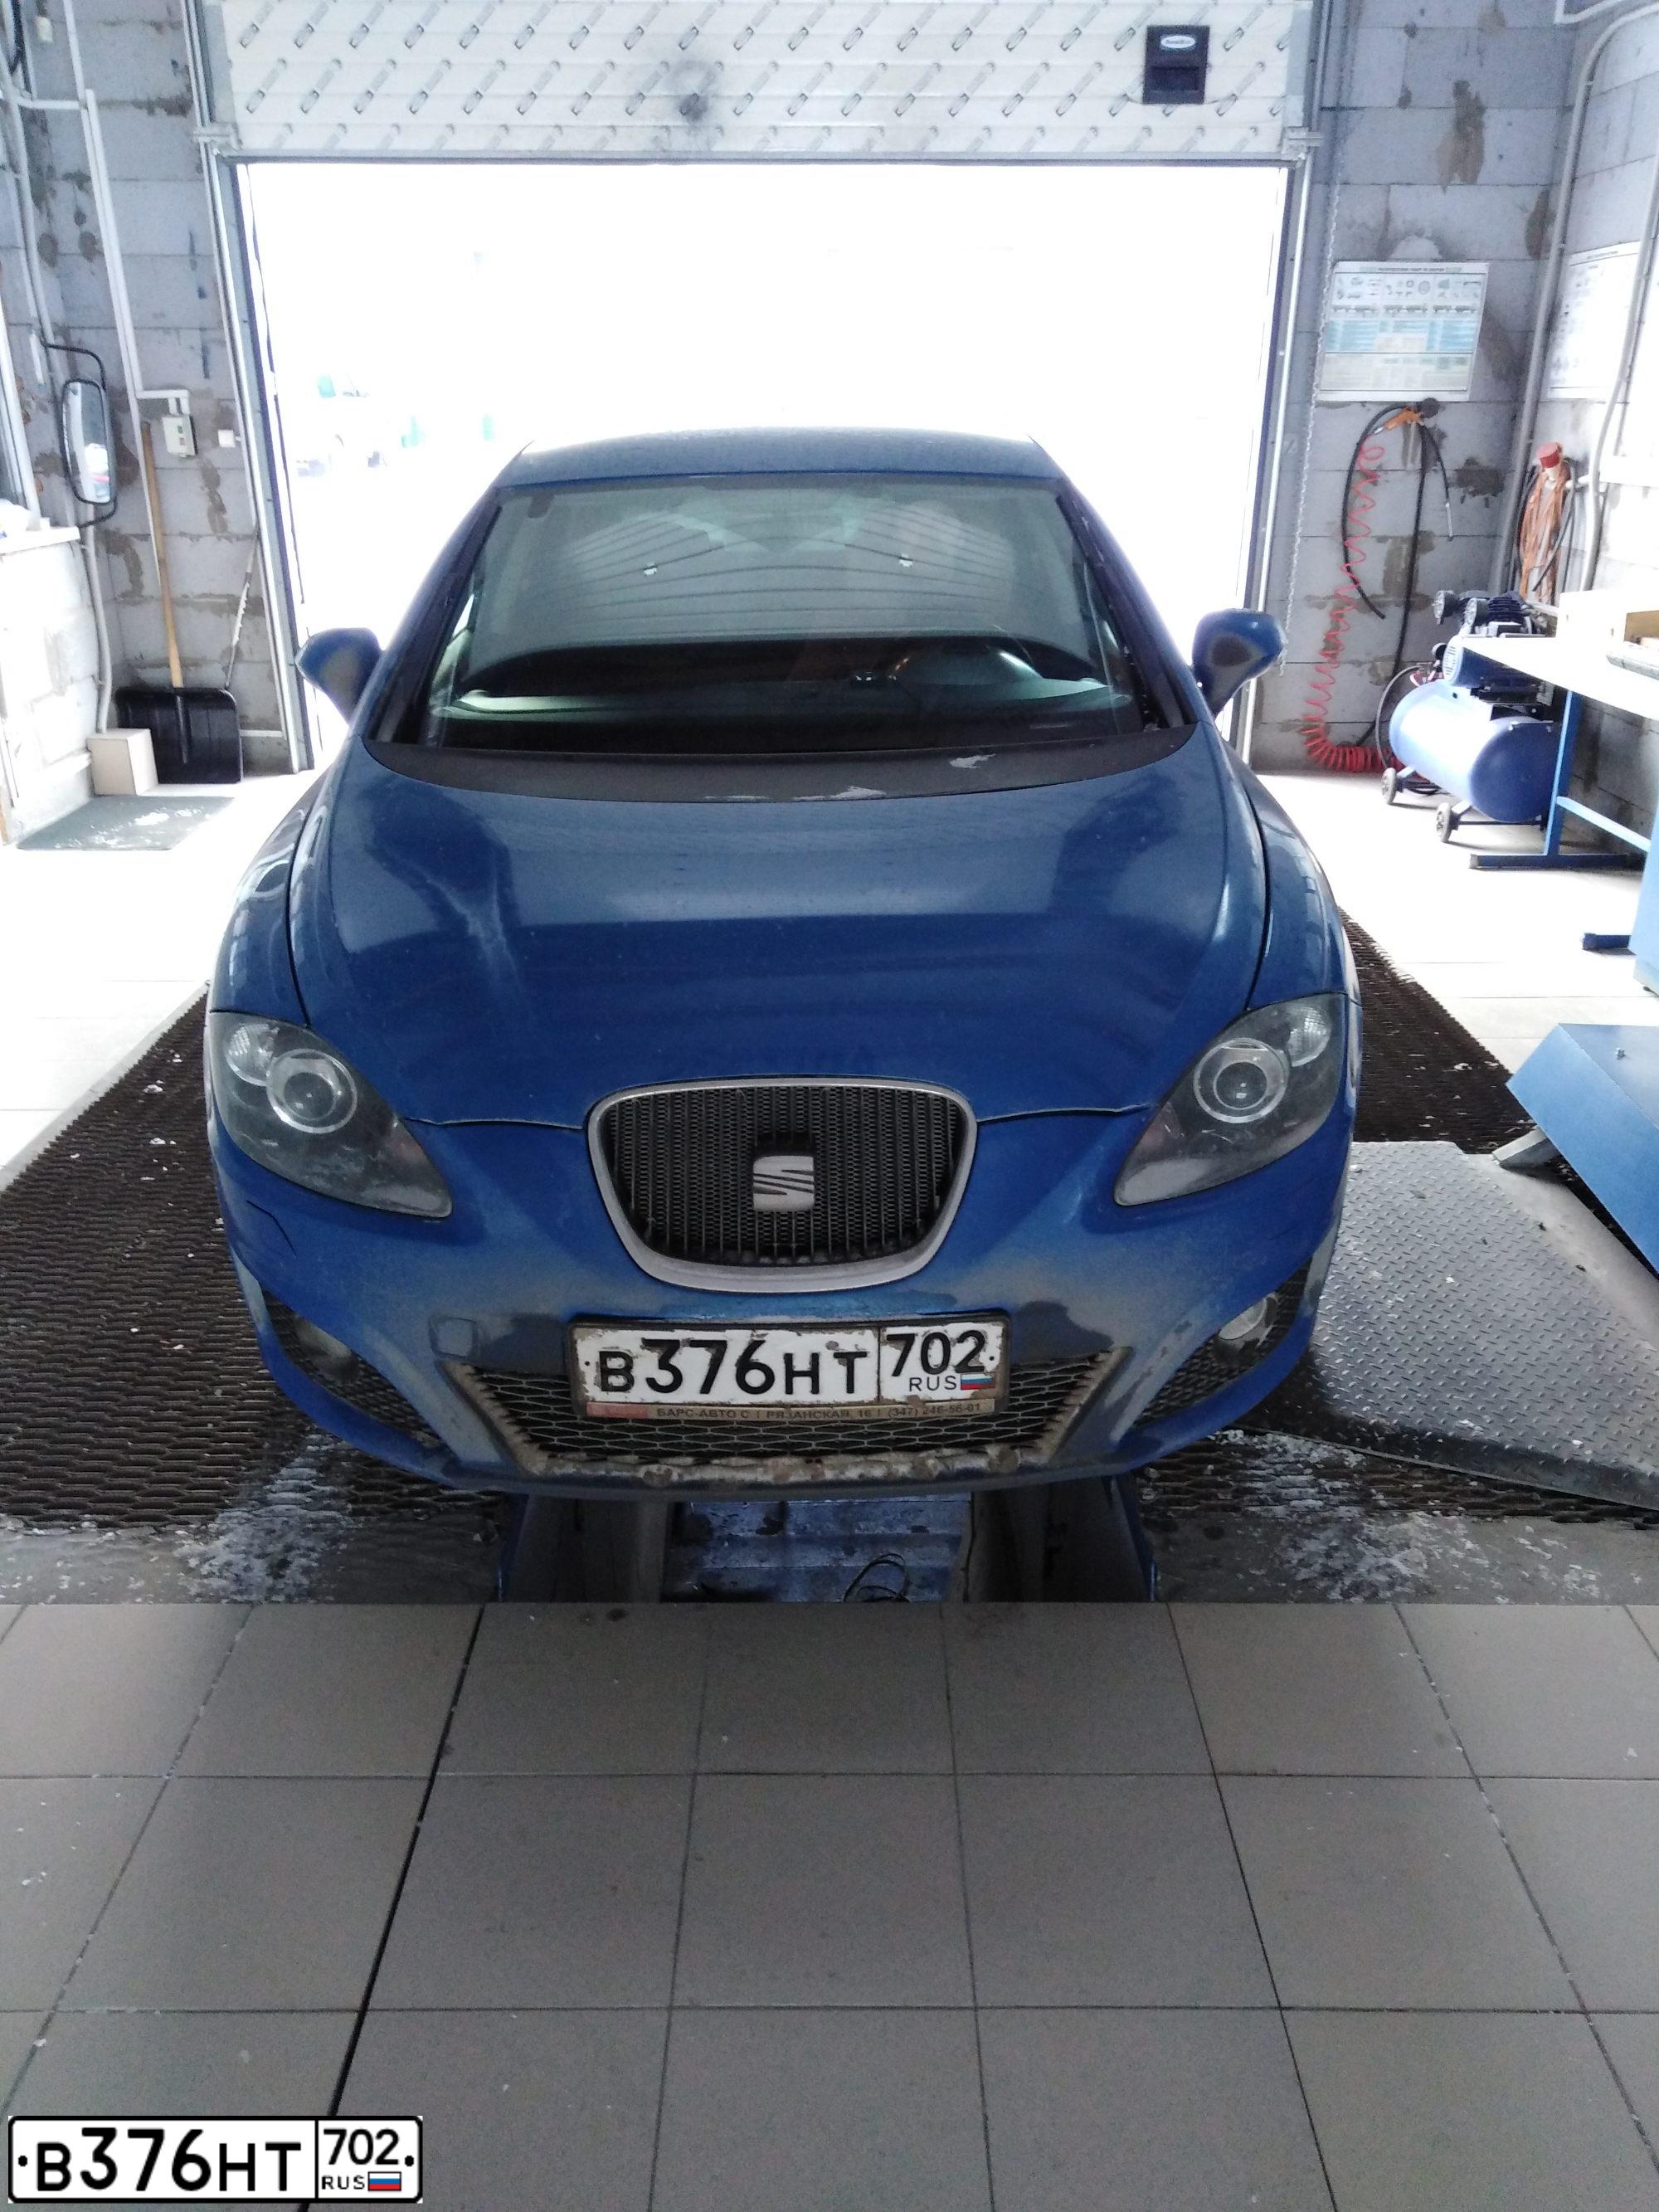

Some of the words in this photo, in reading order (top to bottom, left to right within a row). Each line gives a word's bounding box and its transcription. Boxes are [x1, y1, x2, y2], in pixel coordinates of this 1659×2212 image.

[598, 1337, 868, 1396] В376НТ
[886, 1329, 985, 1377] 702
[907, 1375, 958, 1392] RUS
